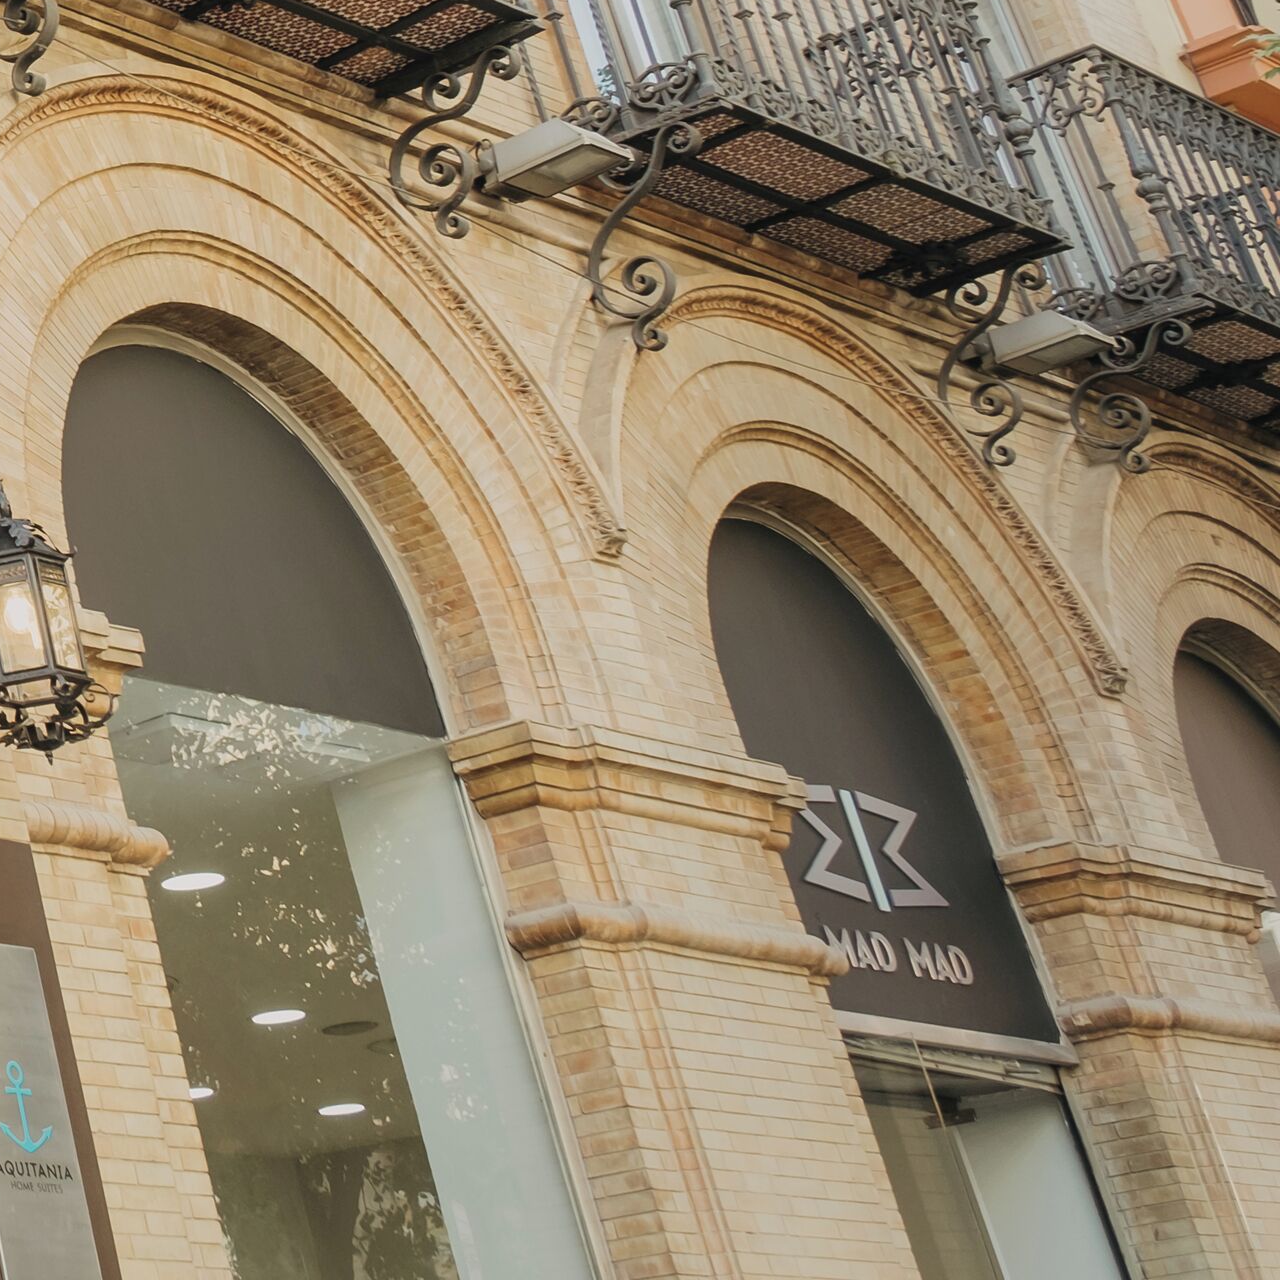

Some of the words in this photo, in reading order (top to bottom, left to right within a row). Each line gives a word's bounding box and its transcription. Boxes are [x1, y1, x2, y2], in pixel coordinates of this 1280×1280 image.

[821, 924, 898, 973] MAD
[903, 937, 974, 985] MAD
[11, 1181, 34, 1192] HOME
[37, 1182, 63, 1194] SUITES
